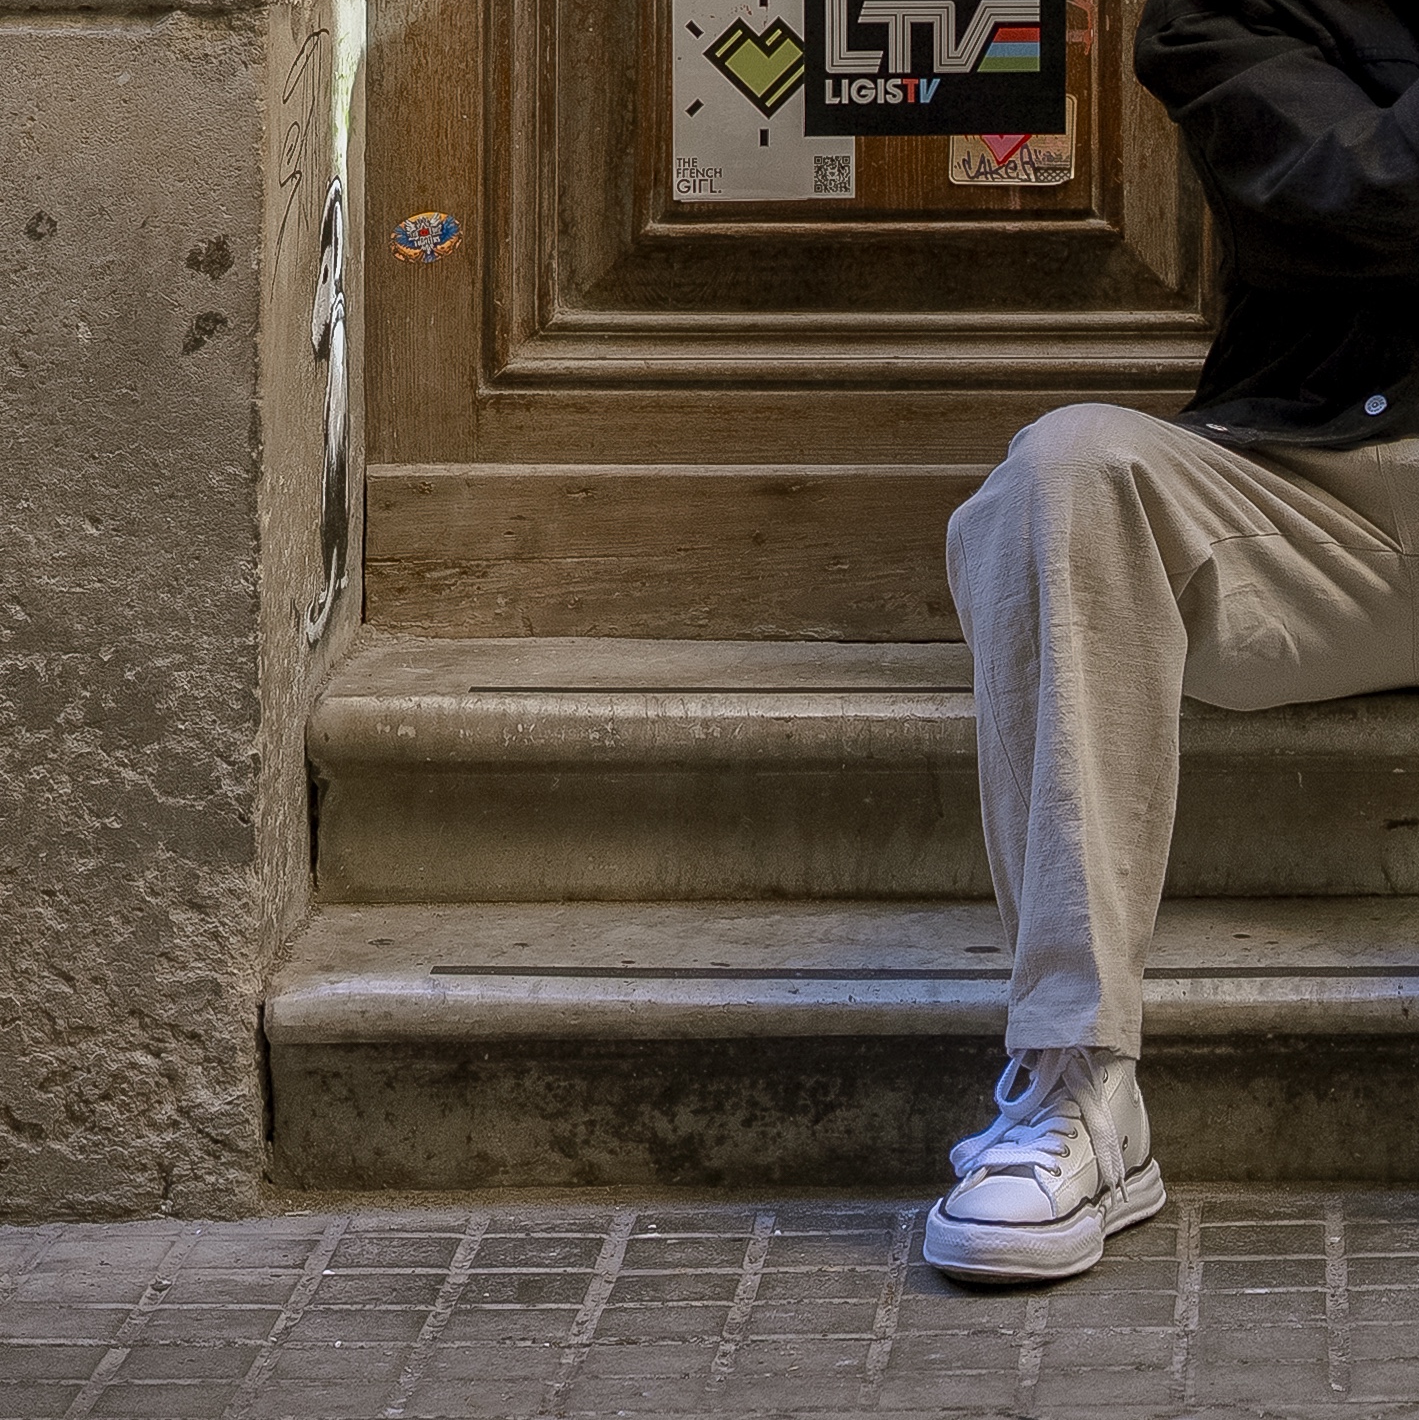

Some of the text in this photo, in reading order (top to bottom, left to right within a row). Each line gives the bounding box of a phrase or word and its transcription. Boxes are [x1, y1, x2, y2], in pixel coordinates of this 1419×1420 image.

[824, 78, 941, 105] LIGISTV
[676, 156, 699, 168] THE
[676, 167, 723, 179] FRENCH
